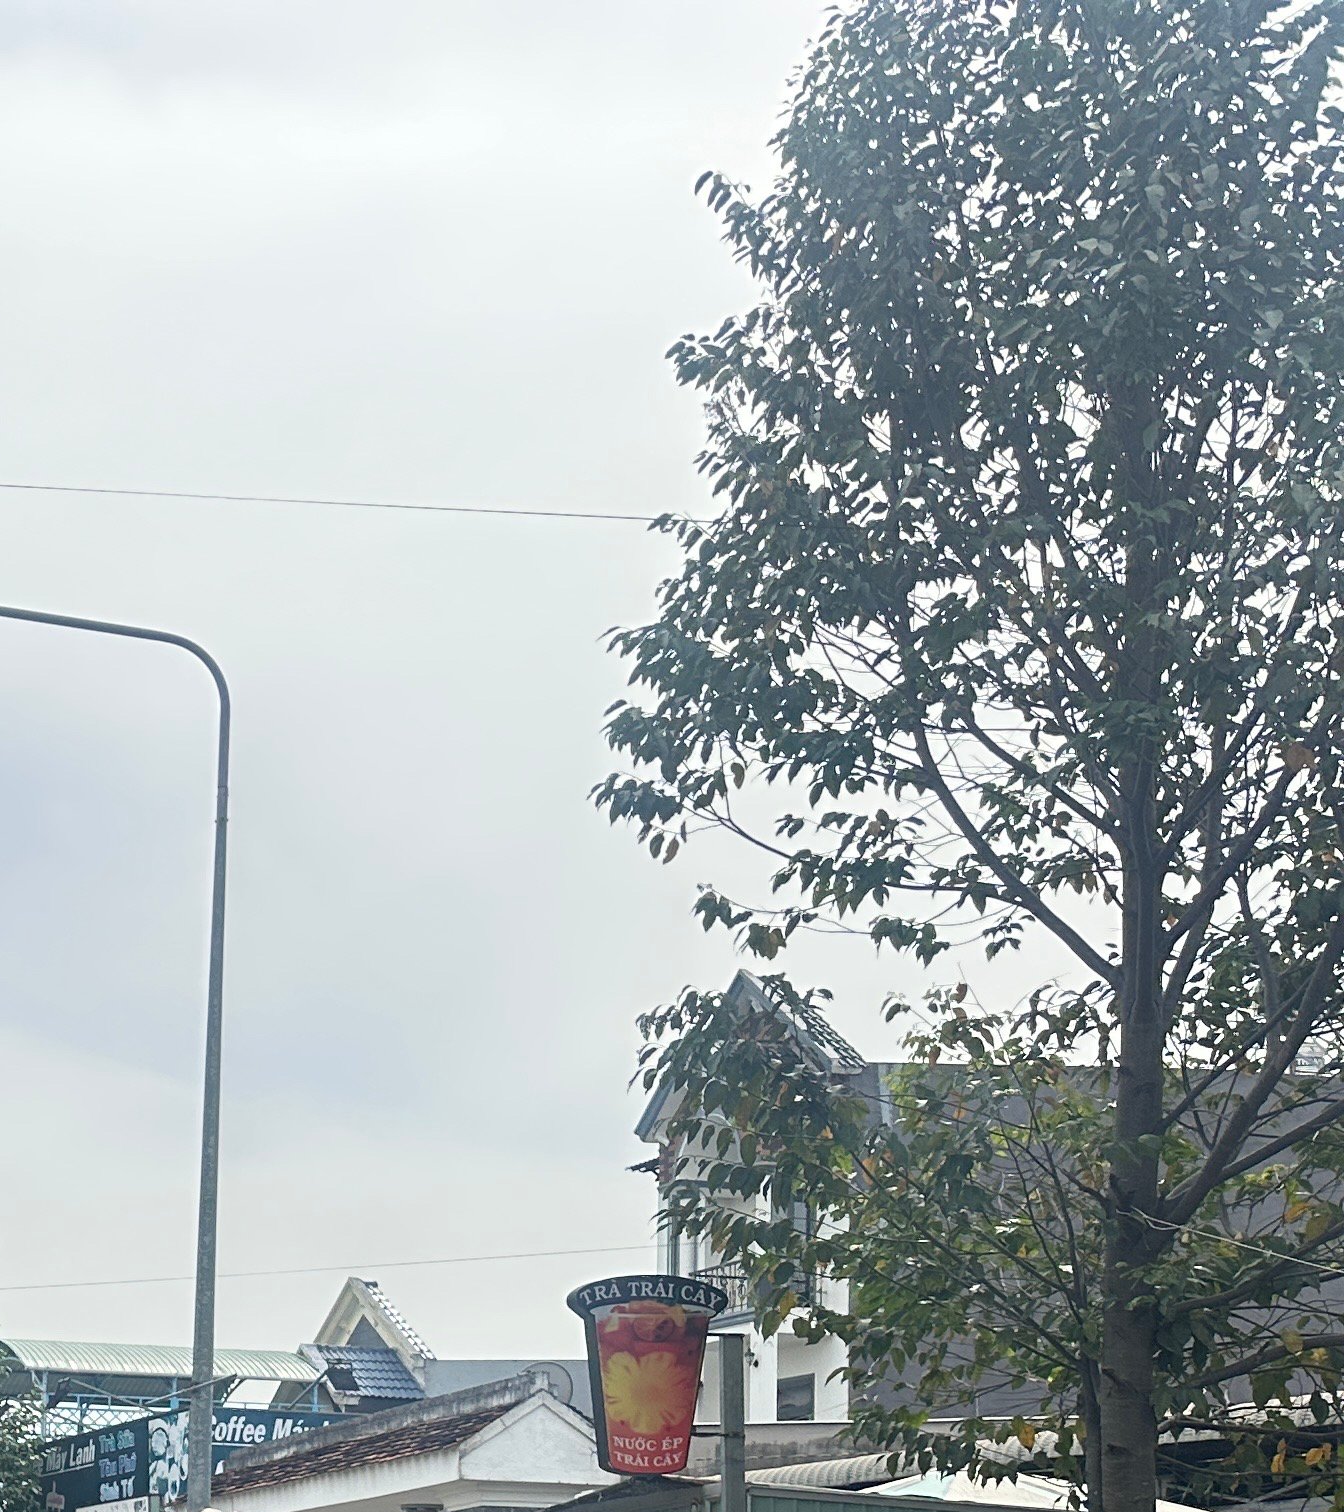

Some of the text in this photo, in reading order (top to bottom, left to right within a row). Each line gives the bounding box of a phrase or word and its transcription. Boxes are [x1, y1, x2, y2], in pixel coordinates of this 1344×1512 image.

[580, 1279, 723, 1309] TRÀ TRÁI CÂY
[613, 1435, 684, 1451] NƯỚC ÉP
[614, 1451, 683, 1467] TRÁI CÂY
